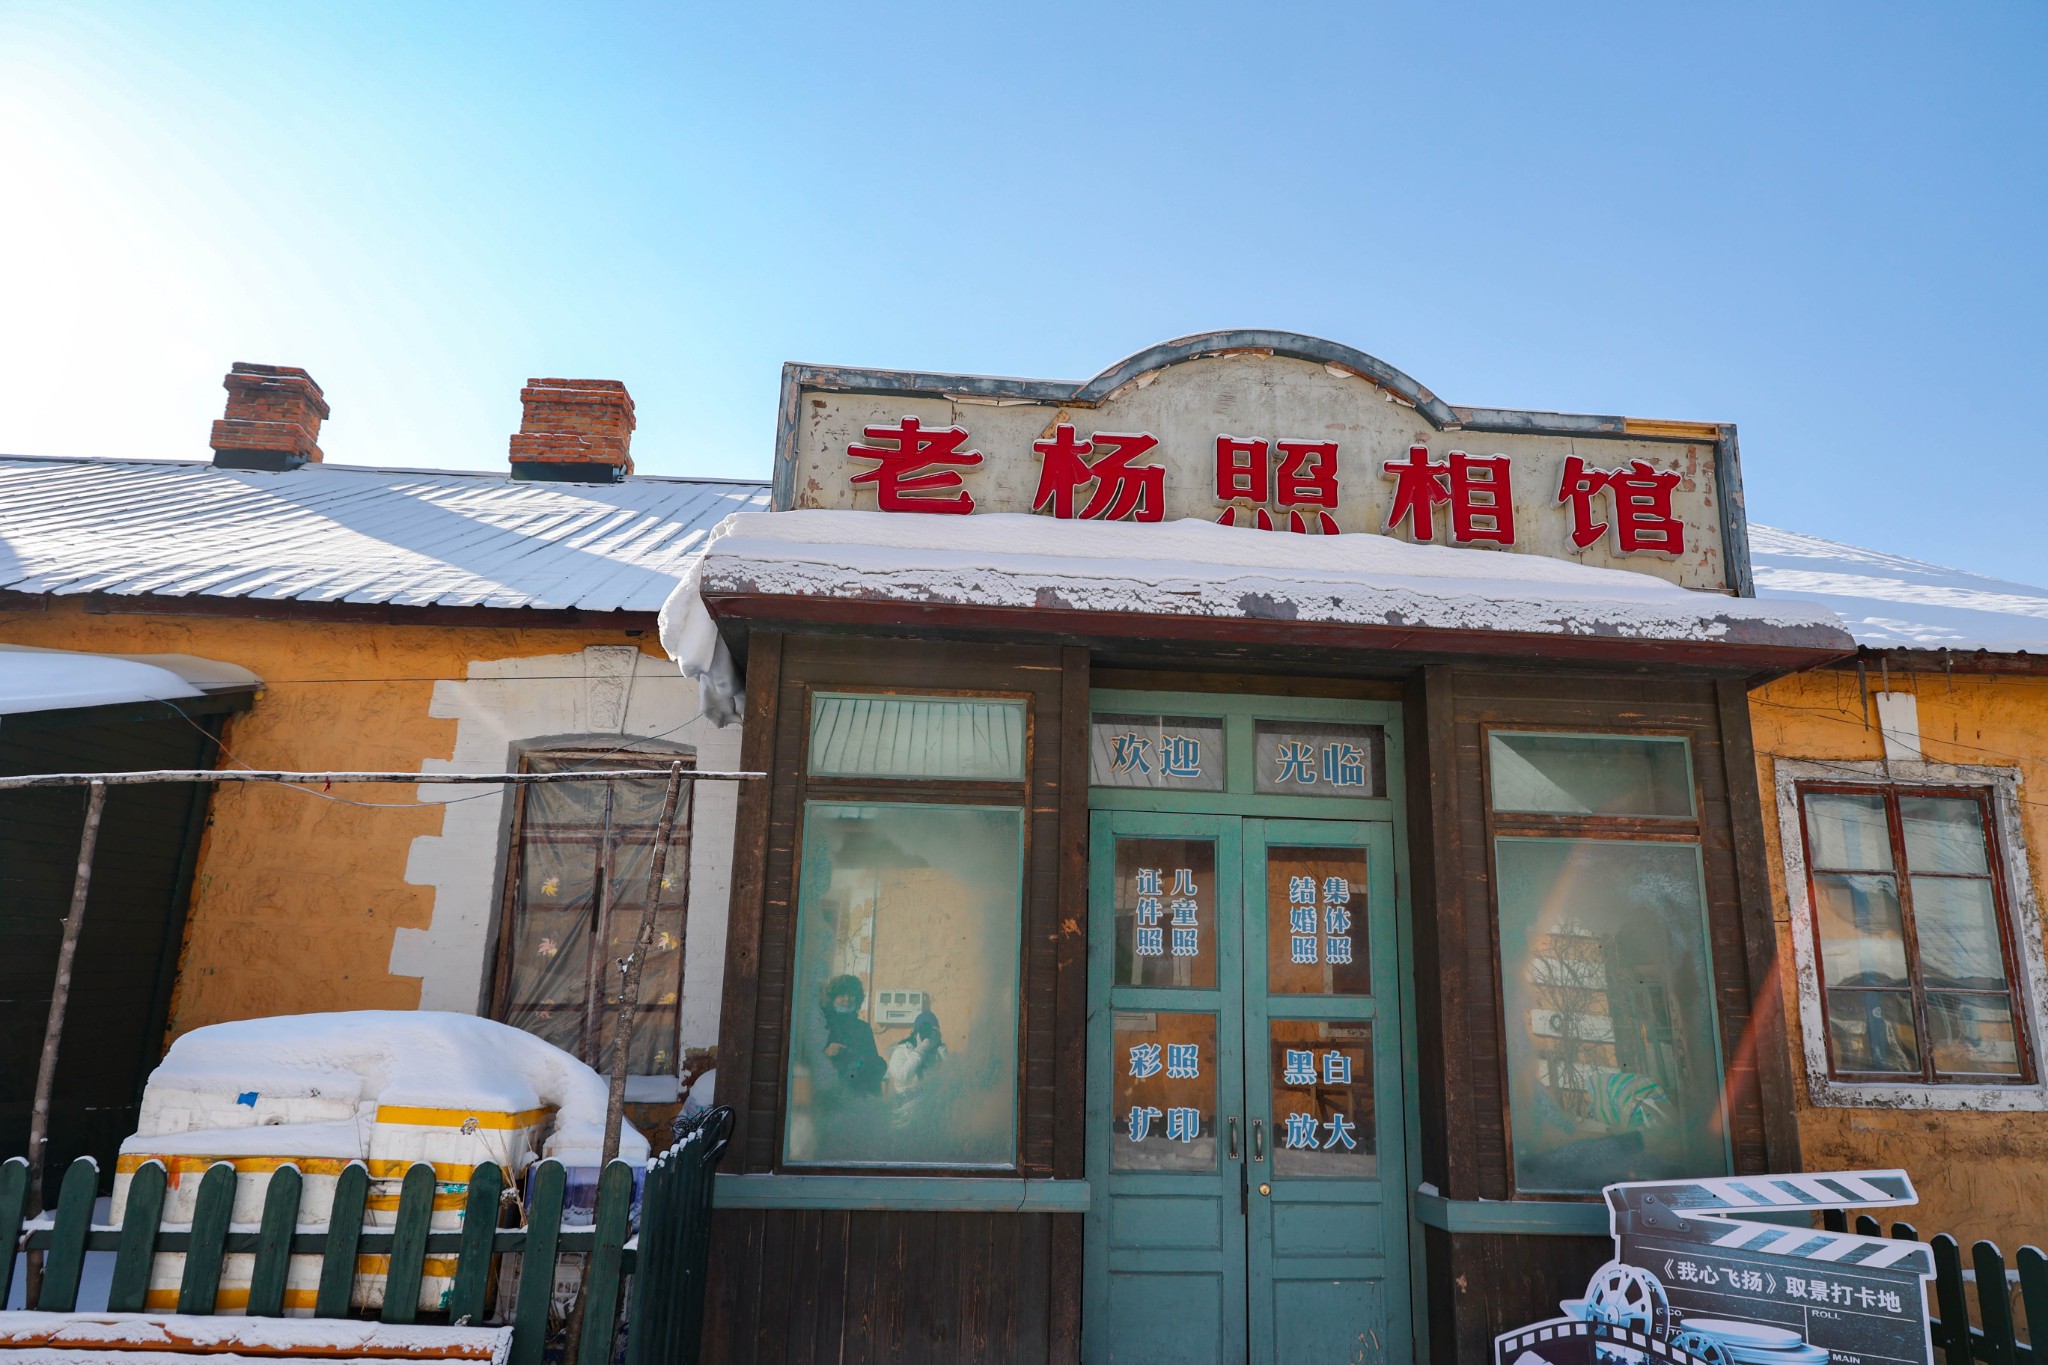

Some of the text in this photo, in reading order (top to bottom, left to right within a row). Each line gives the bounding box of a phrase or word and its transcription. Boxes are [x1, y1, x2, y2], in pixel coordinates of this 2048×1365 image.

[847, 415, 1688, 558] 老杨照相馆
[1109, 732, 1201, 778] 欢迎
[1275, 741, 1365, 786] 光临
[1136, 868, 1163, 955] 证件照
[1170, 869, 1198, 956] 儿童照
[1289, 876, 1318, 964] 结婚照
[1323, 877, 1352, 964] 集体照
[1129, 1043, 1199, 1078] 彩照
[1284, 1050, 1351, 1085] 黑白
[1128, 1106, 1200, 1143] 扩印
[1285, 1113, 1357, 1149] 放大
[1664, 1258, 1902, 1313] 《我心飞扬》取景打卡地
[1812, 1309, 1841, 1320] ROLL
[1832, 1353, 1860, 1364] MAIN
